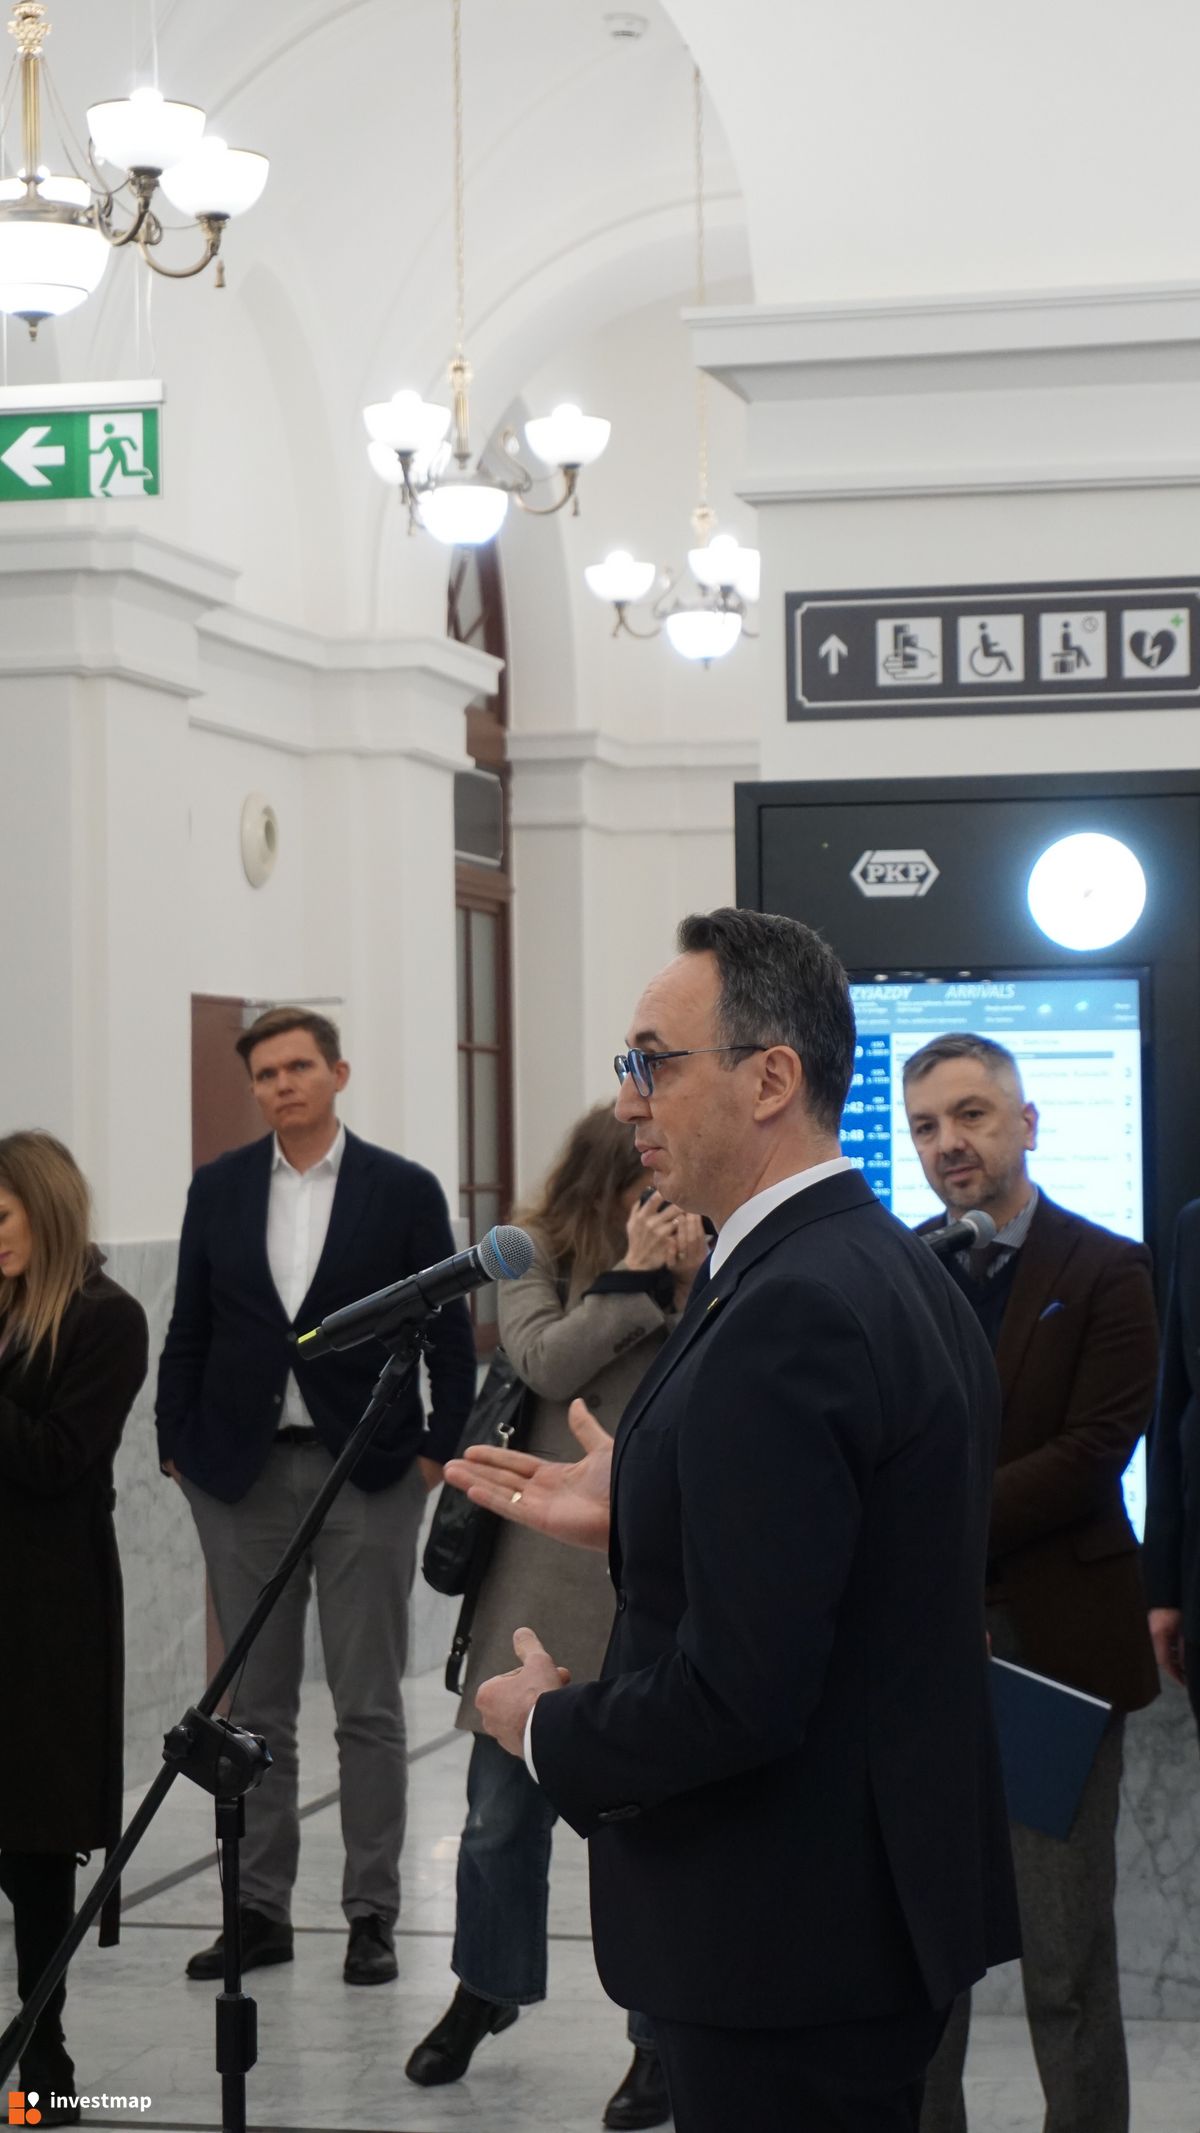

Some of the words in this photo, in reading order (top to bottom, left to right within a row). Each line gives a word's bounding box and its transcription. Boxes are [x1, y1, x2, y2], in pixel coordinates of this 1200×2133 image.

[866, 863, 928, 883] PKP
[849, 985, 913, 1001] ZYJAZDY
[944, 983, 1016, 1000] ARRIVALS
